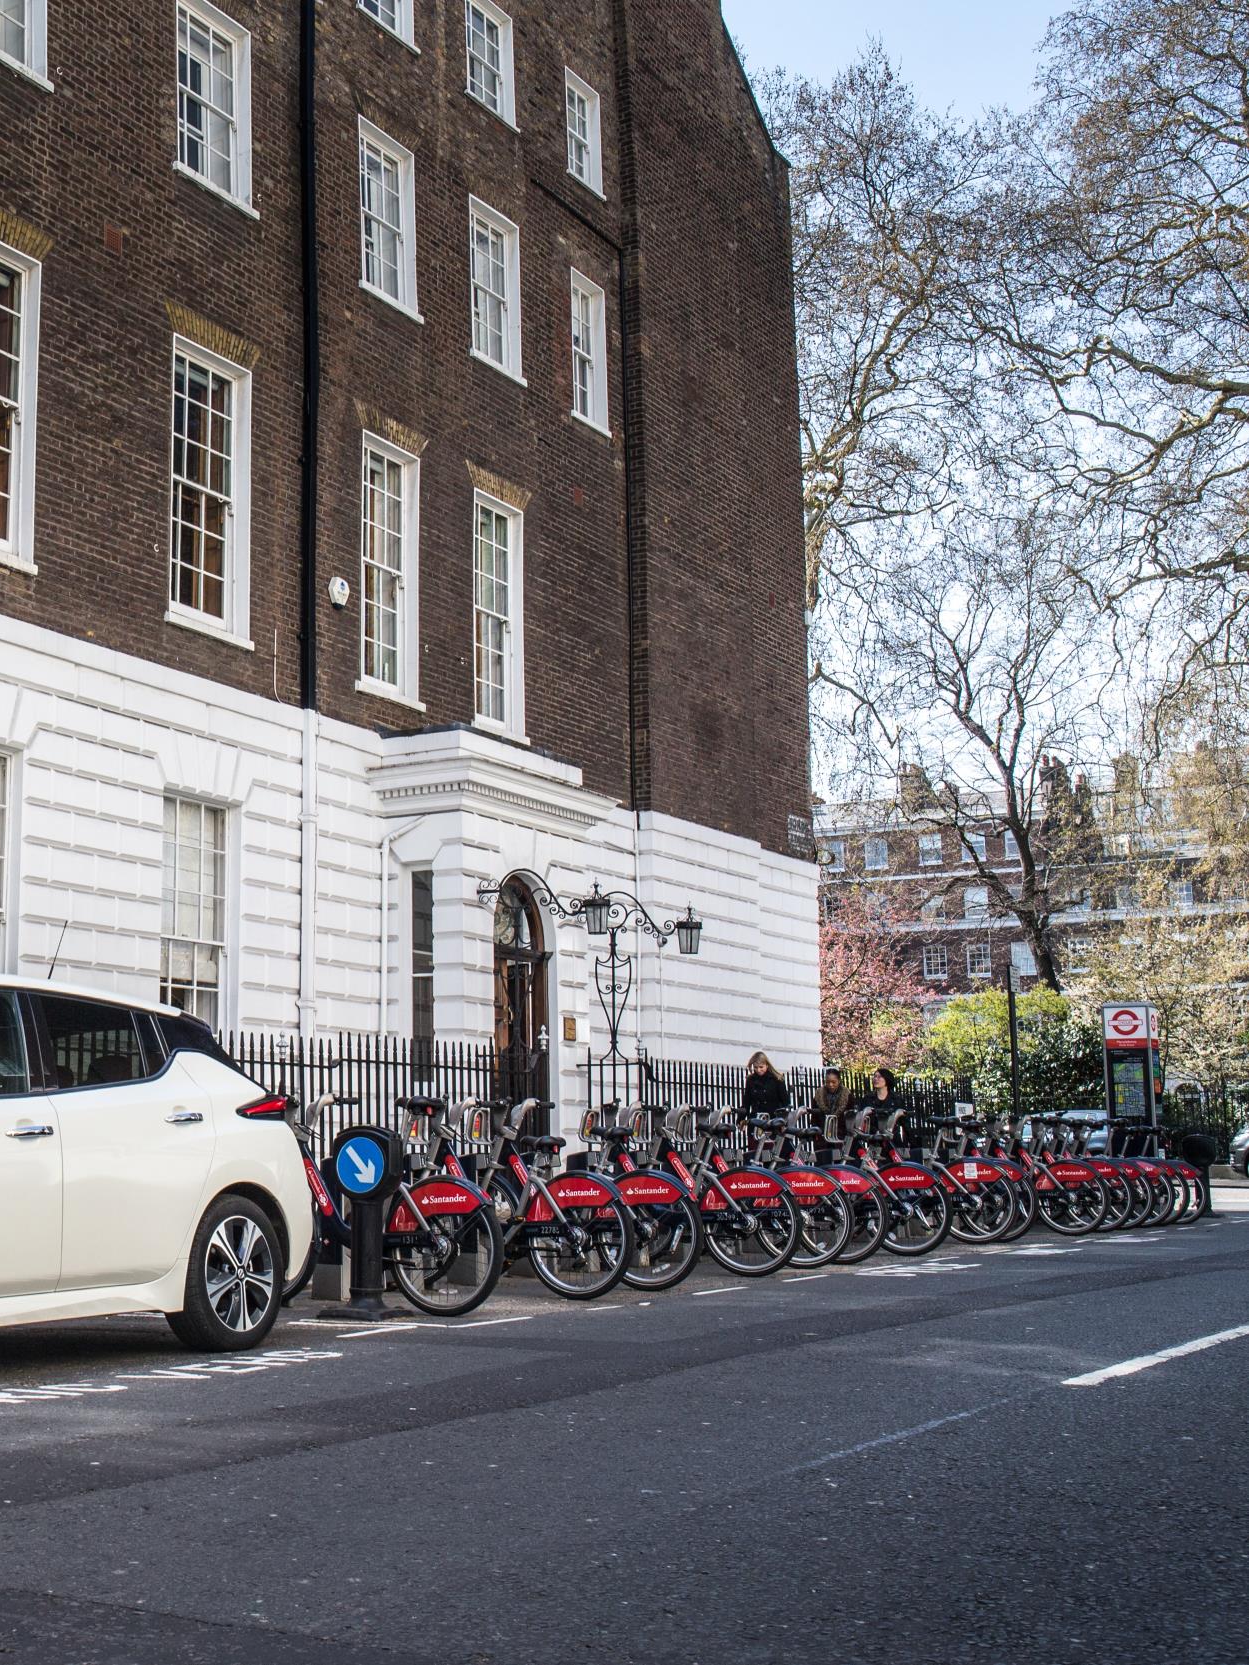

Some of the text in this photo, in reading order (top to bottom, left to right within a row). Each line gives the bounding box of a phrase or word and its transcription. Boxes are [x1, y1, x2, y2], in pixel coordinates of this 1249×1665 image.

[737, 1181, 771, 1189] Santander
[566, 1188, 600, 1197] Santander
[634, 1187, 669, 1196] Santander
[429, 1193, 467, 1204] Santander
